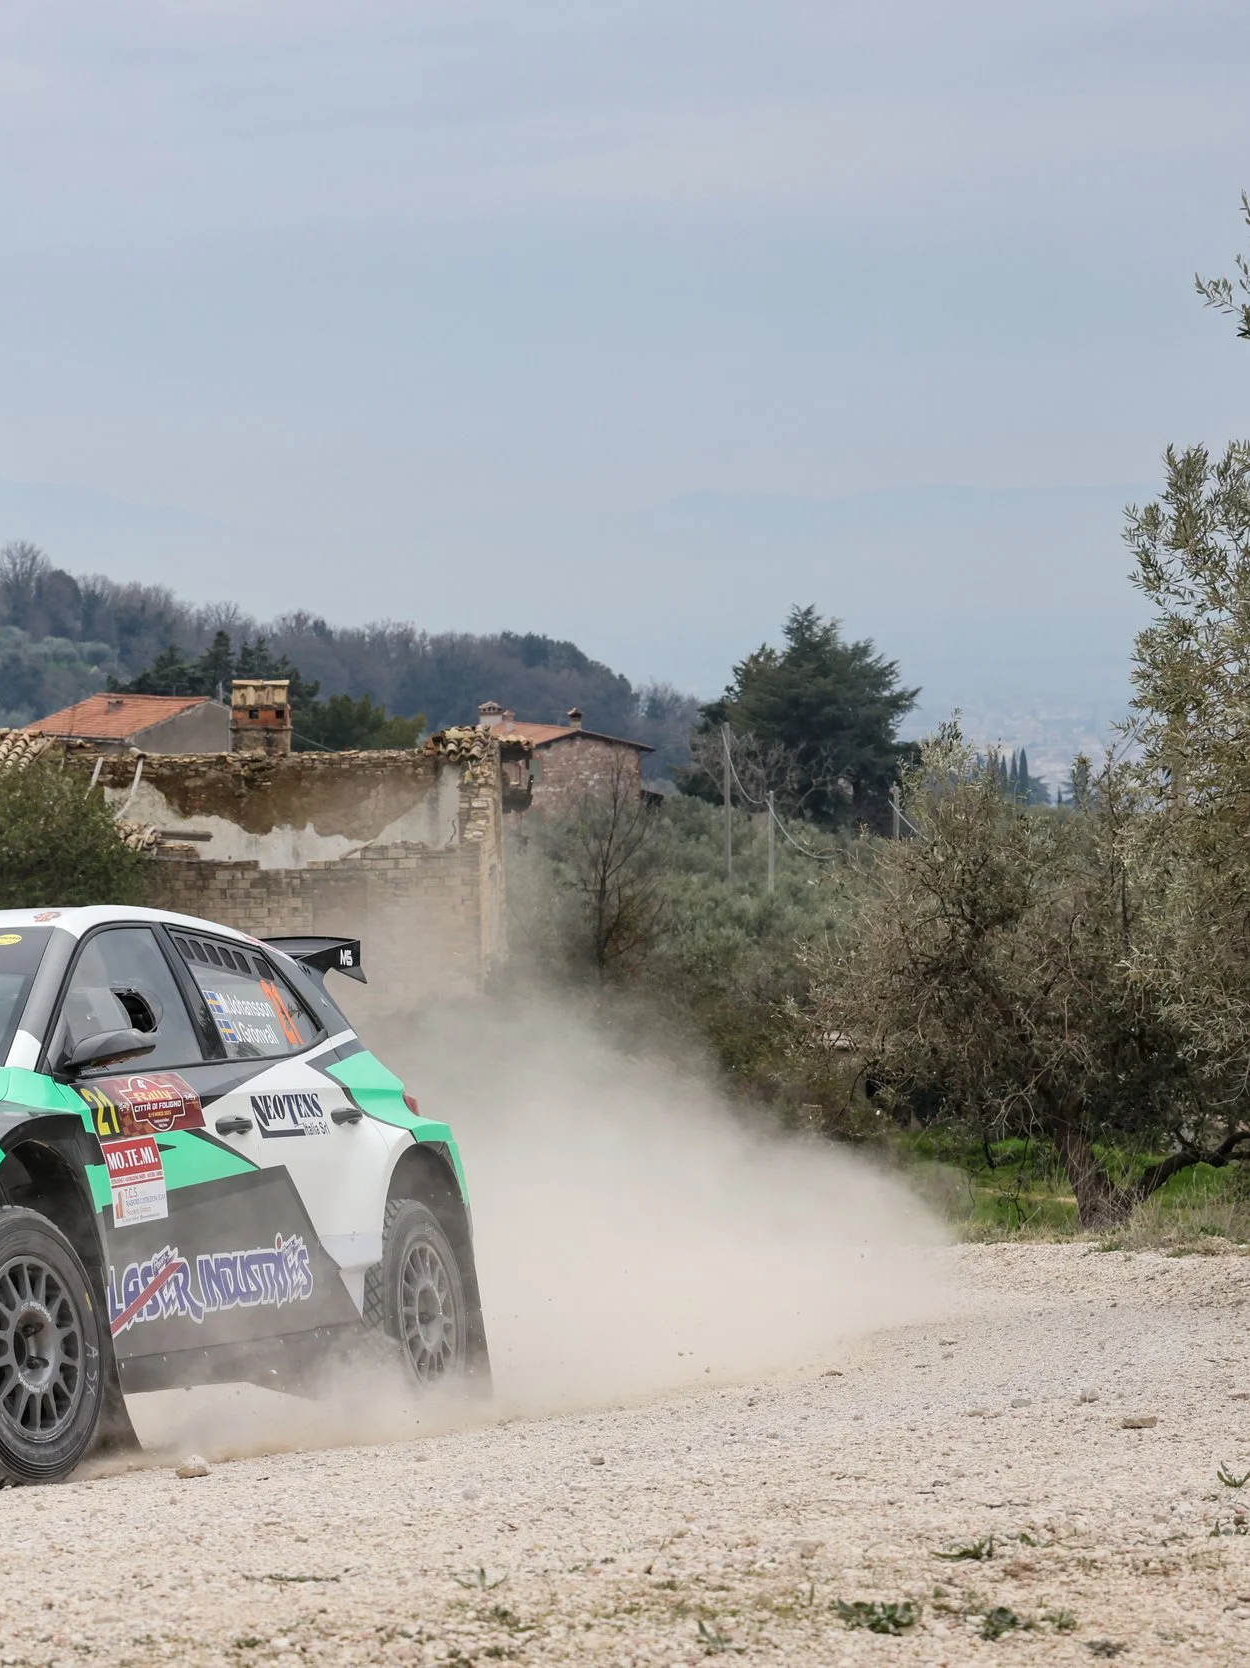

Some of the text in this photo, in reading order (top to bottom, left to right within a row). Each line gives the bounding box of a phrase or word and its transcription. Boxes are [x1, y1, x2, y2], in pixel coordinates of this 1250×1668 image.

[339, 948, 353, 967] MS
[233, 1021, 280, 1045] J.Grönvall
[132, 1089, 173, 1102] Rally
[152, 1102, 159, 1111] DI
[159, 1099, 182, 1110] FOLIGNO
[80, 1086, 120, 1136] 21
[250, 1093, 323, 1127] NEOTENS
[107, 1146, 158, 1171] MO.TE.MI.
